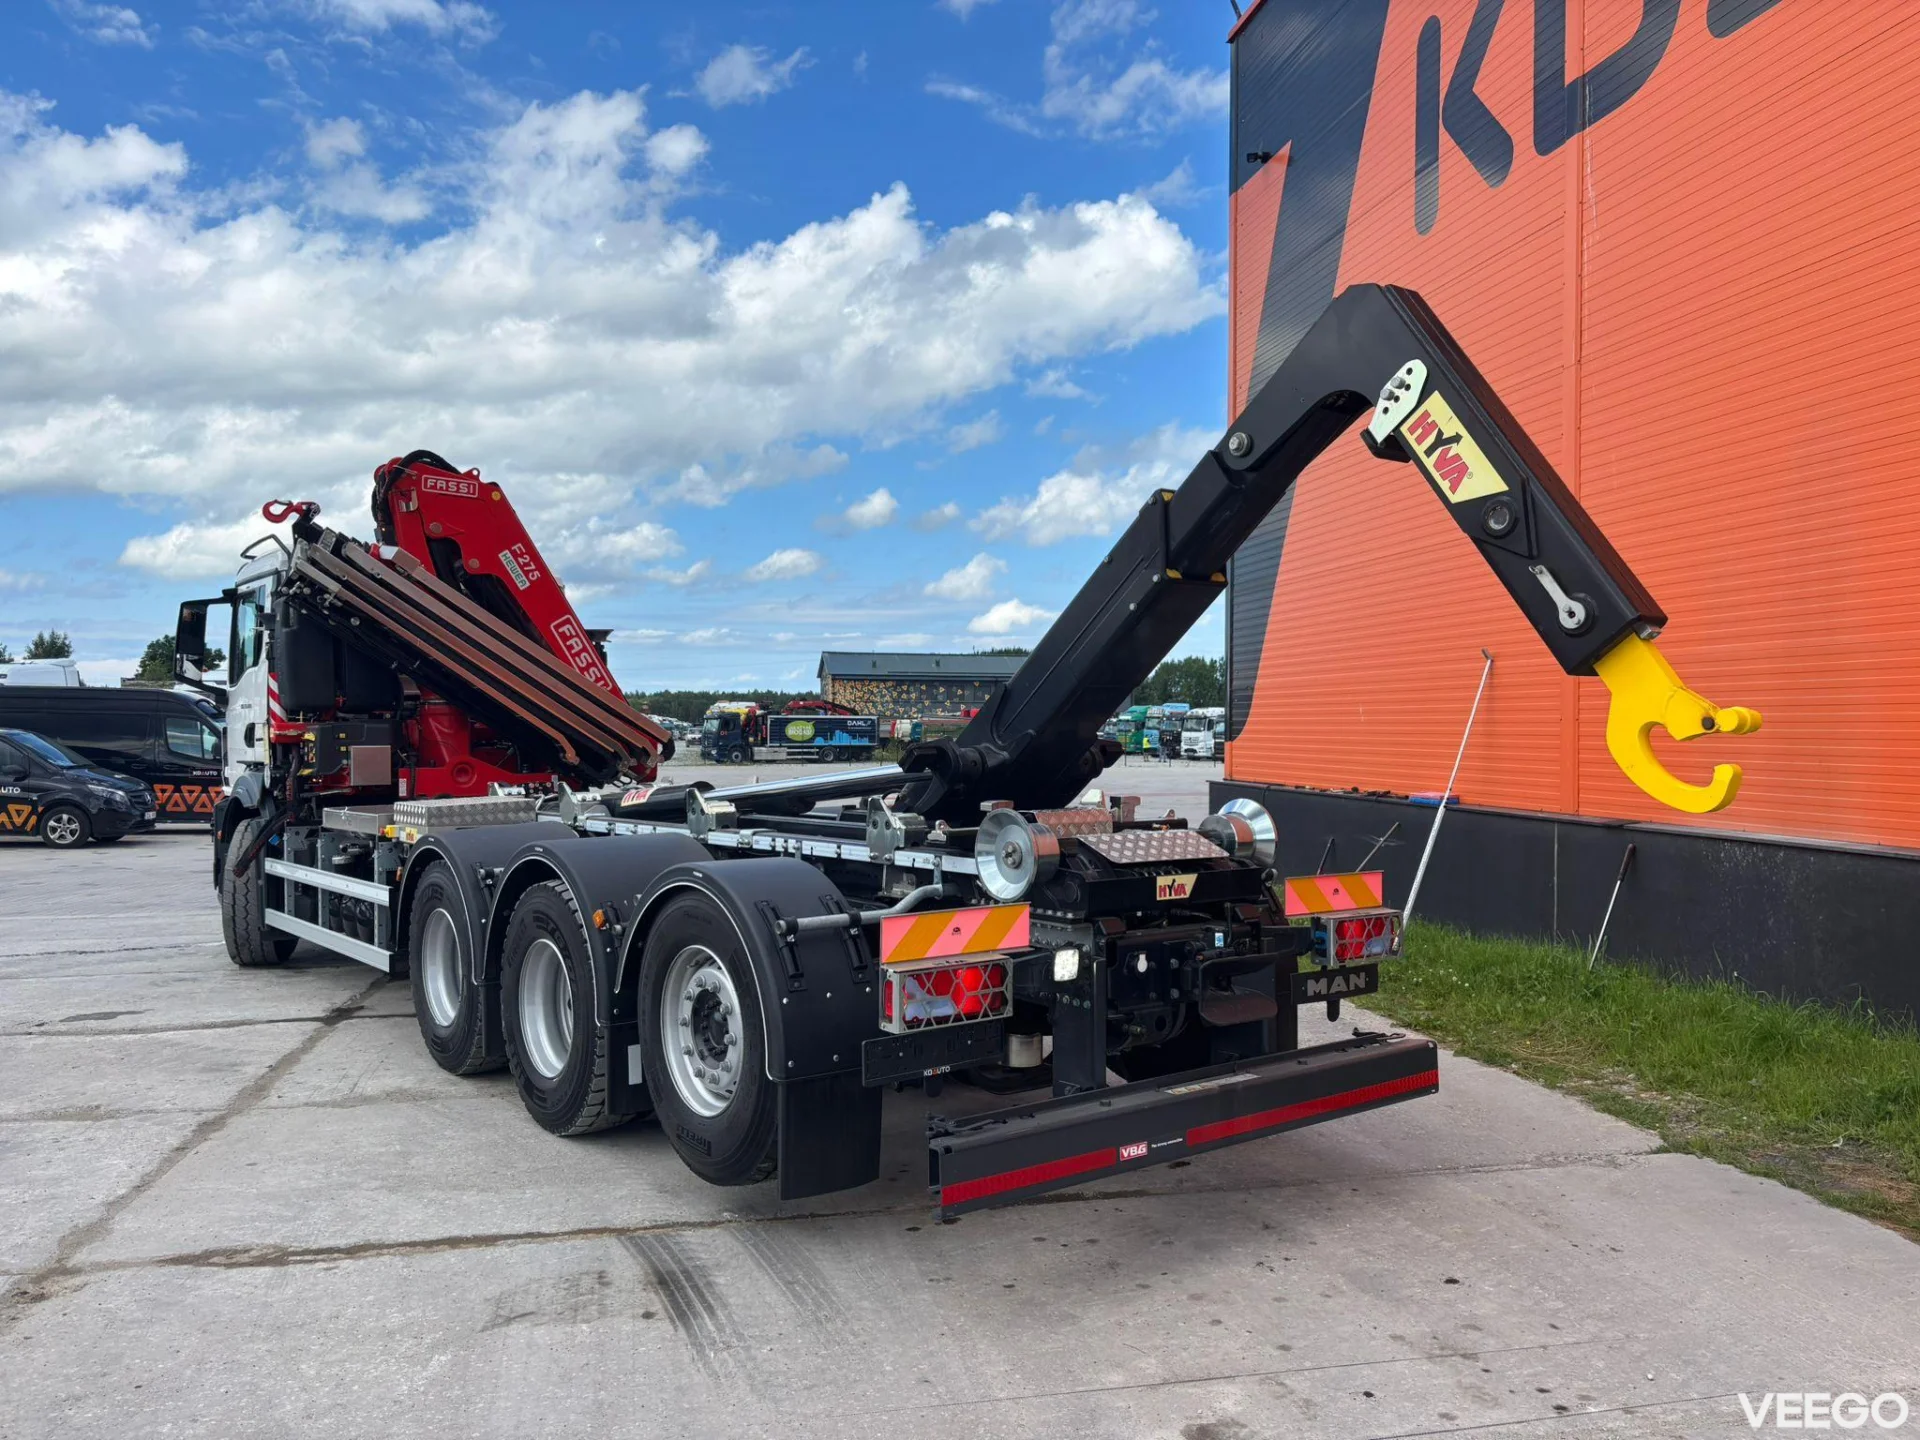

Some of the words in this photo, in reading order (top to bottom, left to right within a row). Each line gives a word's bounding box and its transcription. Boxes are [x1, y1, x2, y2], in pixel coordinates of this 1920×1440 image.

[1414, 0, 1784, 236] KD
[1407, 409, 1470, 496] HYVA
[426, 479, 474, 494] FASSI
[512, 543, 541, 581] F275
[0, 786, 21, 794] UTO
[1158, 879, 1187, 898] HYVA
[1307, 972, 1366, 996] MAN
[1121, 1144, 1146, 1158] VBG
